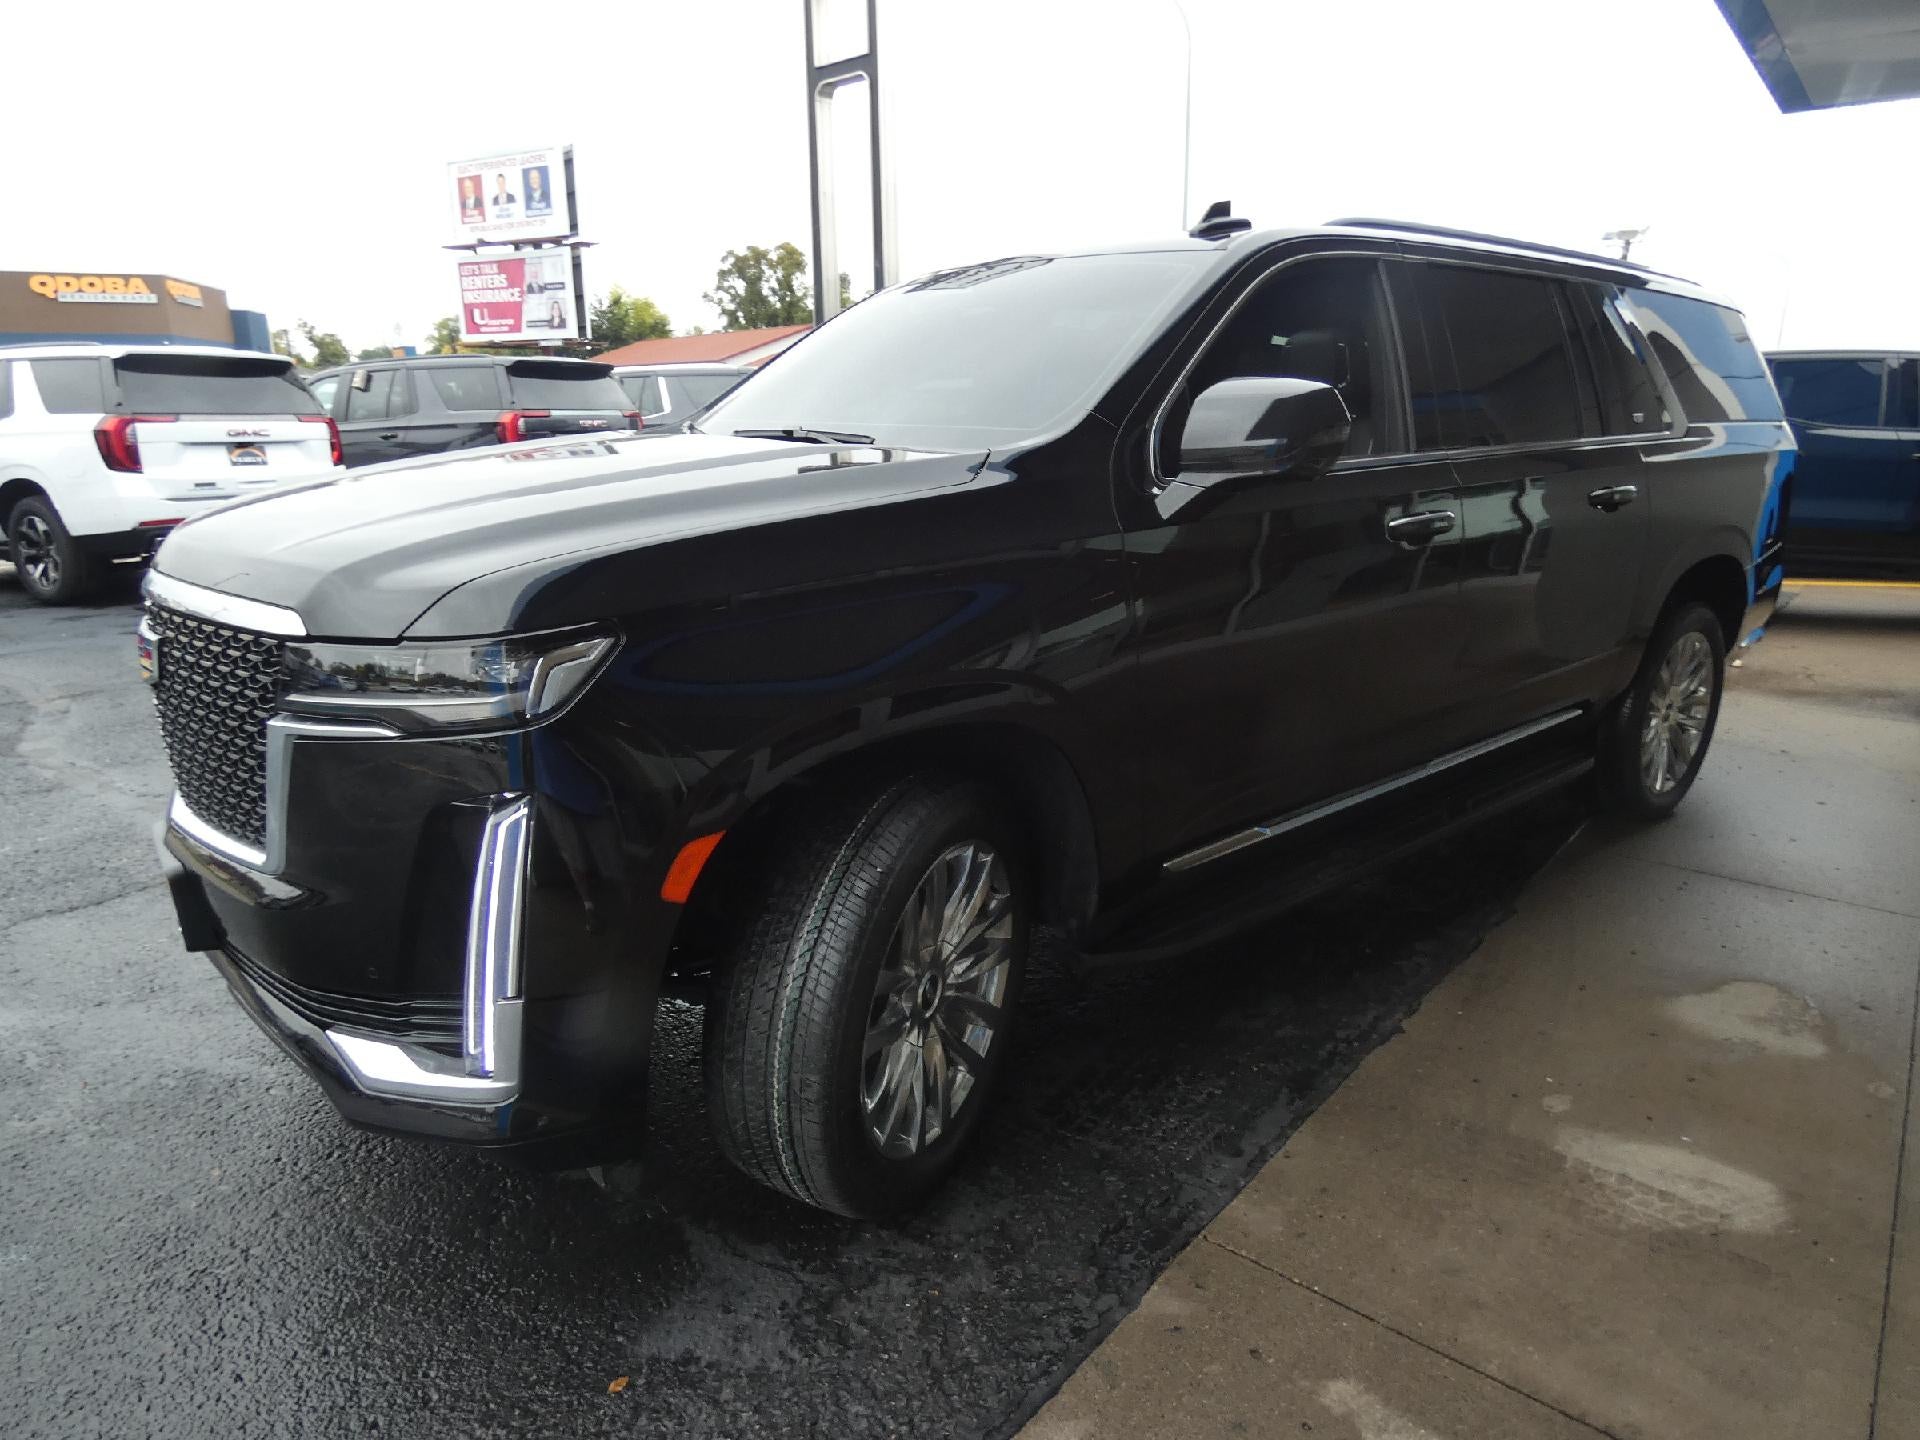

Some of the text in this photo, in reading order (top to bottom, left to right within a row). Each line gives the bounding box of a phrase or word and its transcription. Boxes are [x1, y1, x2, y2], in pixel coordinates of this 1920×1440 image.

[29, 275, 151, 299] QDOBA
[461, 274, 508, 290] RENTERS
[463, 288, 522, 304] INSURANCE
[227, 428, 271, 437] GMC
